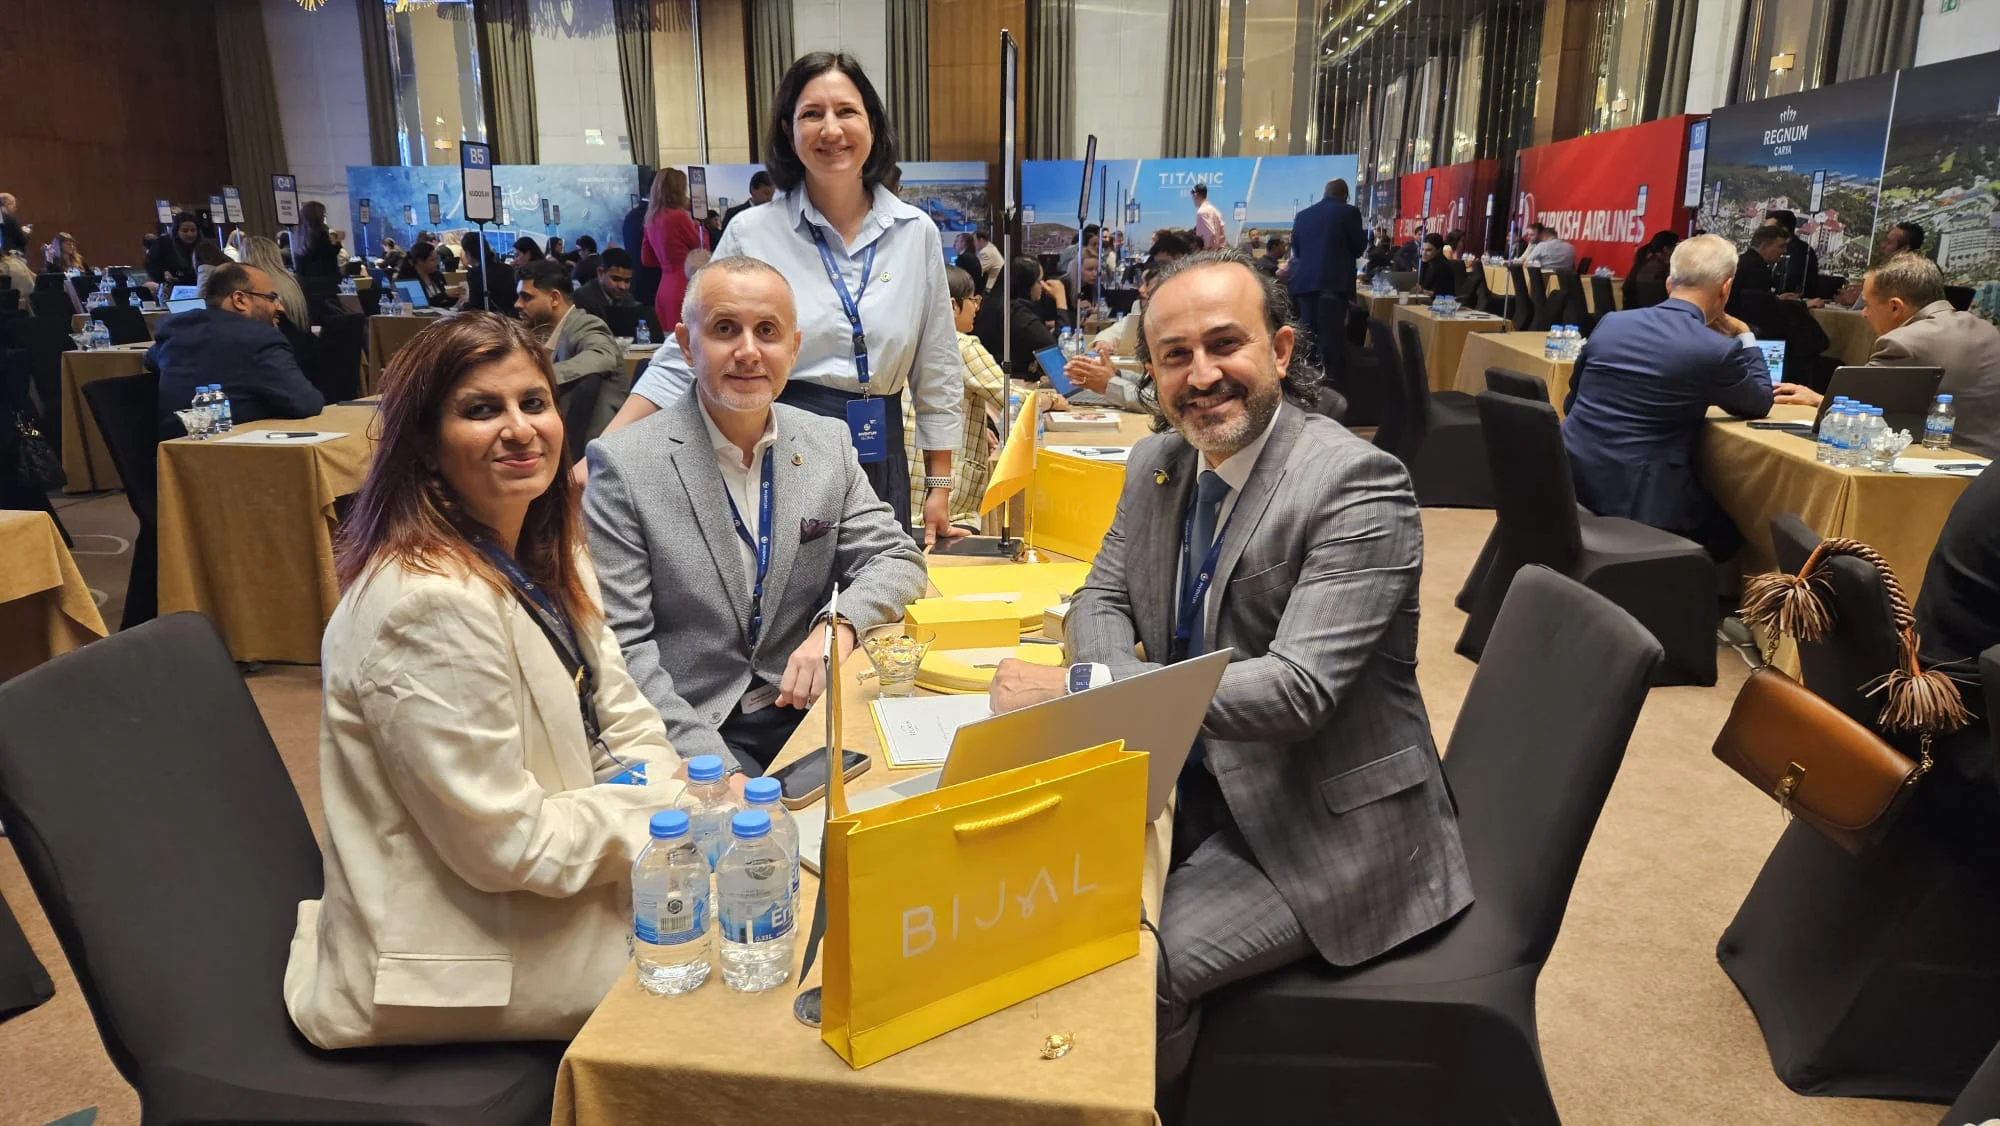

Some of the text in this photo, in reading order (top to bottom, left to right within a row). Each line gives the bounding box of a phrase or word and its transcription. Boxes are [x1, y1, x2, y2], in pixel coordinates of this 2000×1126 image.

[1763, 124, 1809, 146] REGNUM
[470, 148, 484, 165] B5
[1774, 145, 1792, 157] CARYA
[278, 177, 290, 189] C4
[1158, 172, 1224, 185] TITANIC
[1581, 209, 1645, 244] AIRLINES
[901, 852, 1099, 960] BIJAL
